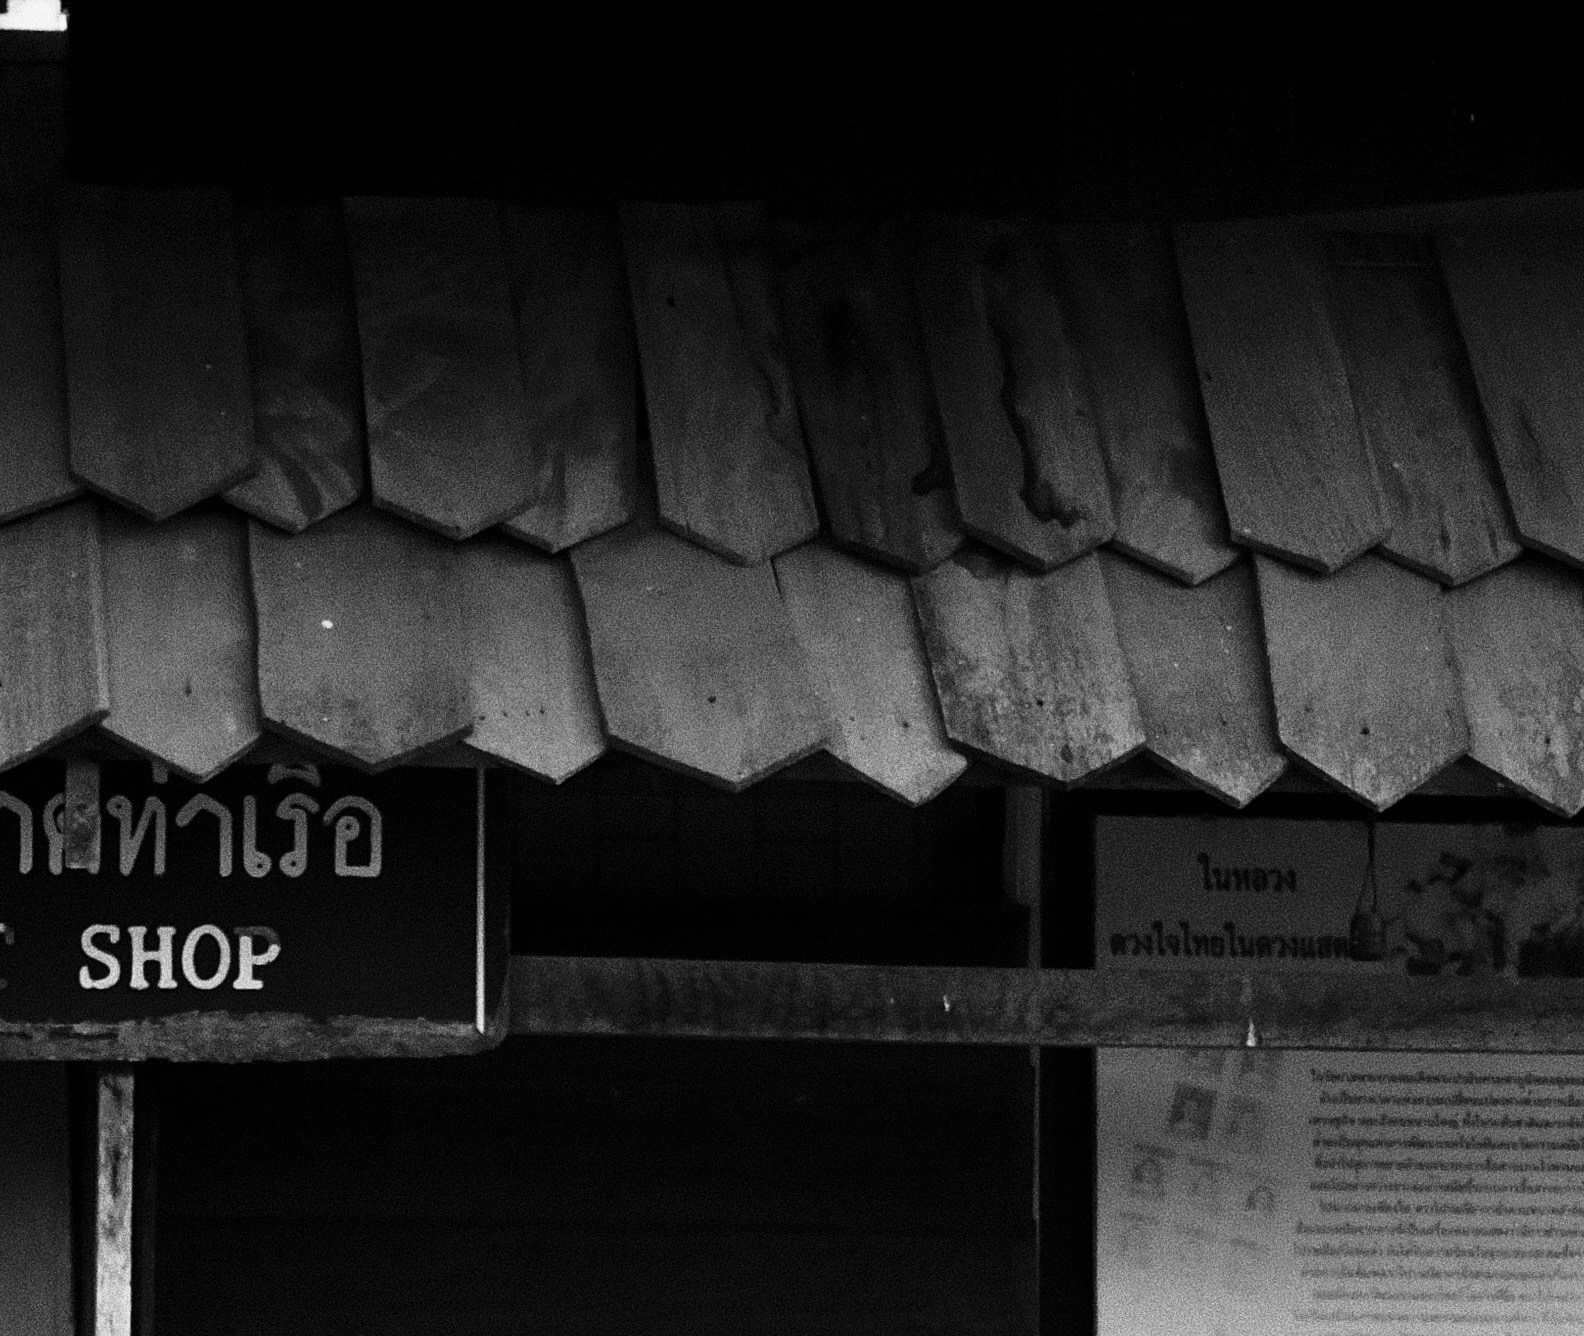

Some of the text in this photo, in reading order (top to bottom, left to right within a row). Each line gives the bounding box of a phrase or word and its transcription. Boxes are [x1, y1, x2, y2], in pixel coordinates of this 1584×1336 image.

[1196, 851, 1297, 893] ในหลวง
[78, 922, 282, 991] SHOP
[1110, 920, 1352, 959] ดวงใจไทยในดวงแสต
